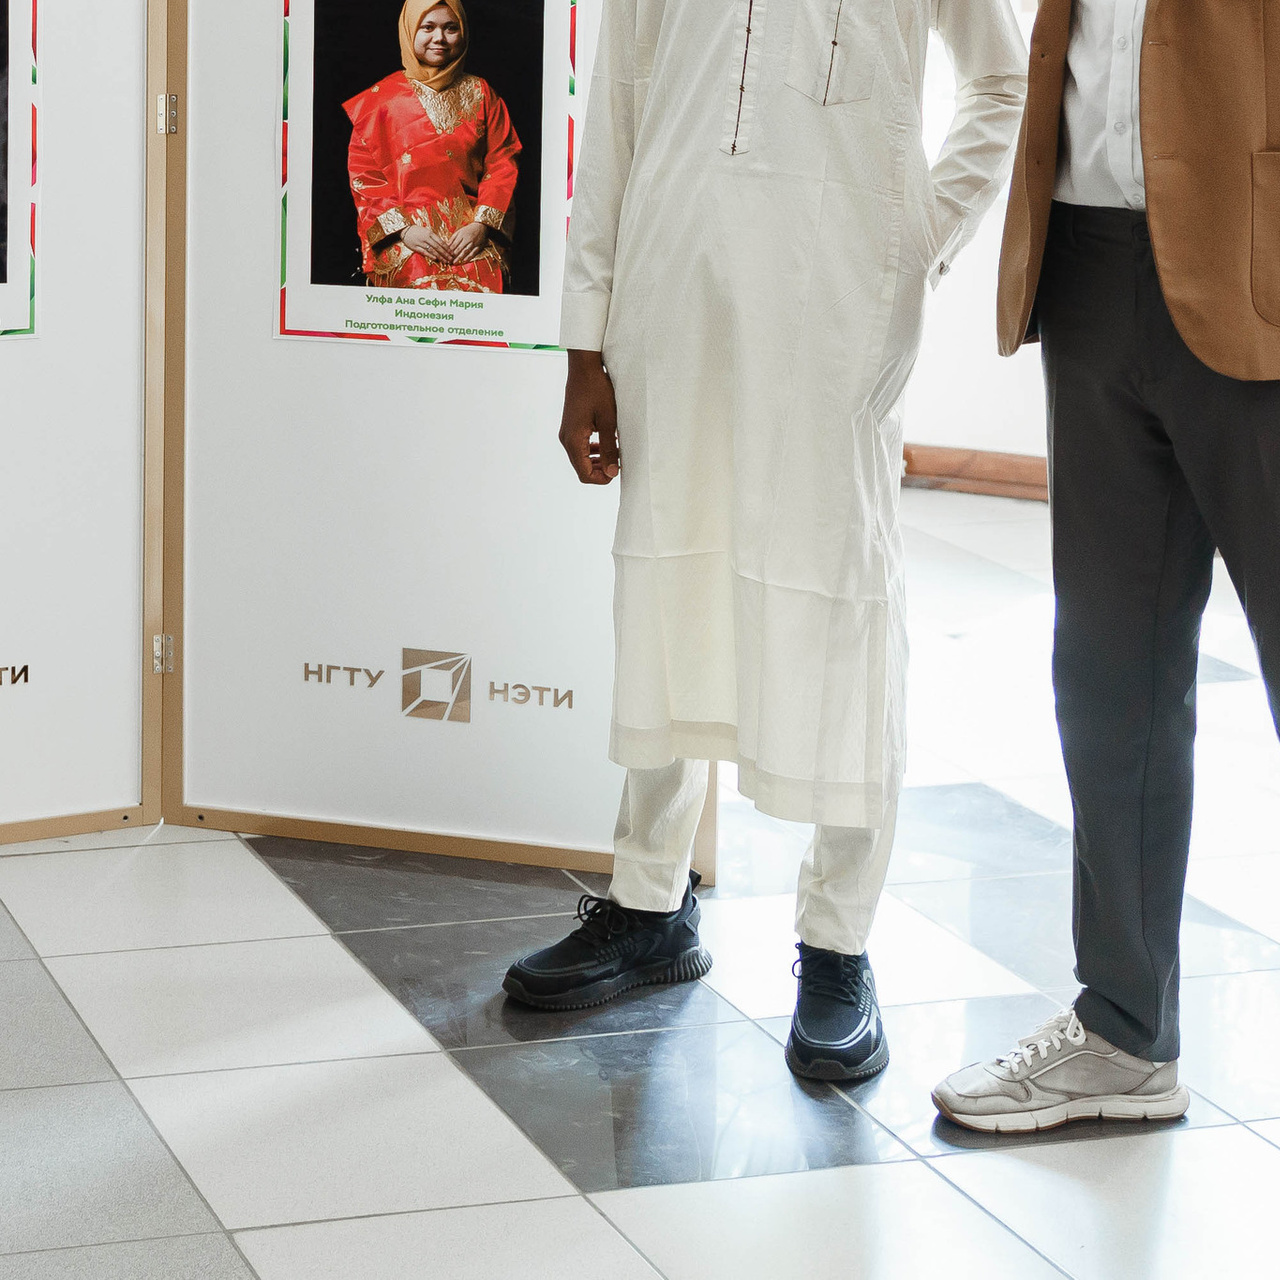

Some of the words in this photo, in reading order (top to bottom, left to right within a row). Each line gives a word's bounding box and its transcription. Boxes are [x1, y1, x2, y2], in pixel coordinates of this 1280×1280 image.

[365, 294, 393, 305] Улфа
[395, 296, 415, 305] Ана
[418, 297, 447, 308] Сефи
[449, 299, 484, 309] Мария
[394, 309, 454, 321] Индонезия
[345, 319, 445, 334] Подготовительное
[447, 327, 504, 337] отделение
[303, 662, 385, 688] НГТУ
[489, 681, 574, 709] НЭТИ
